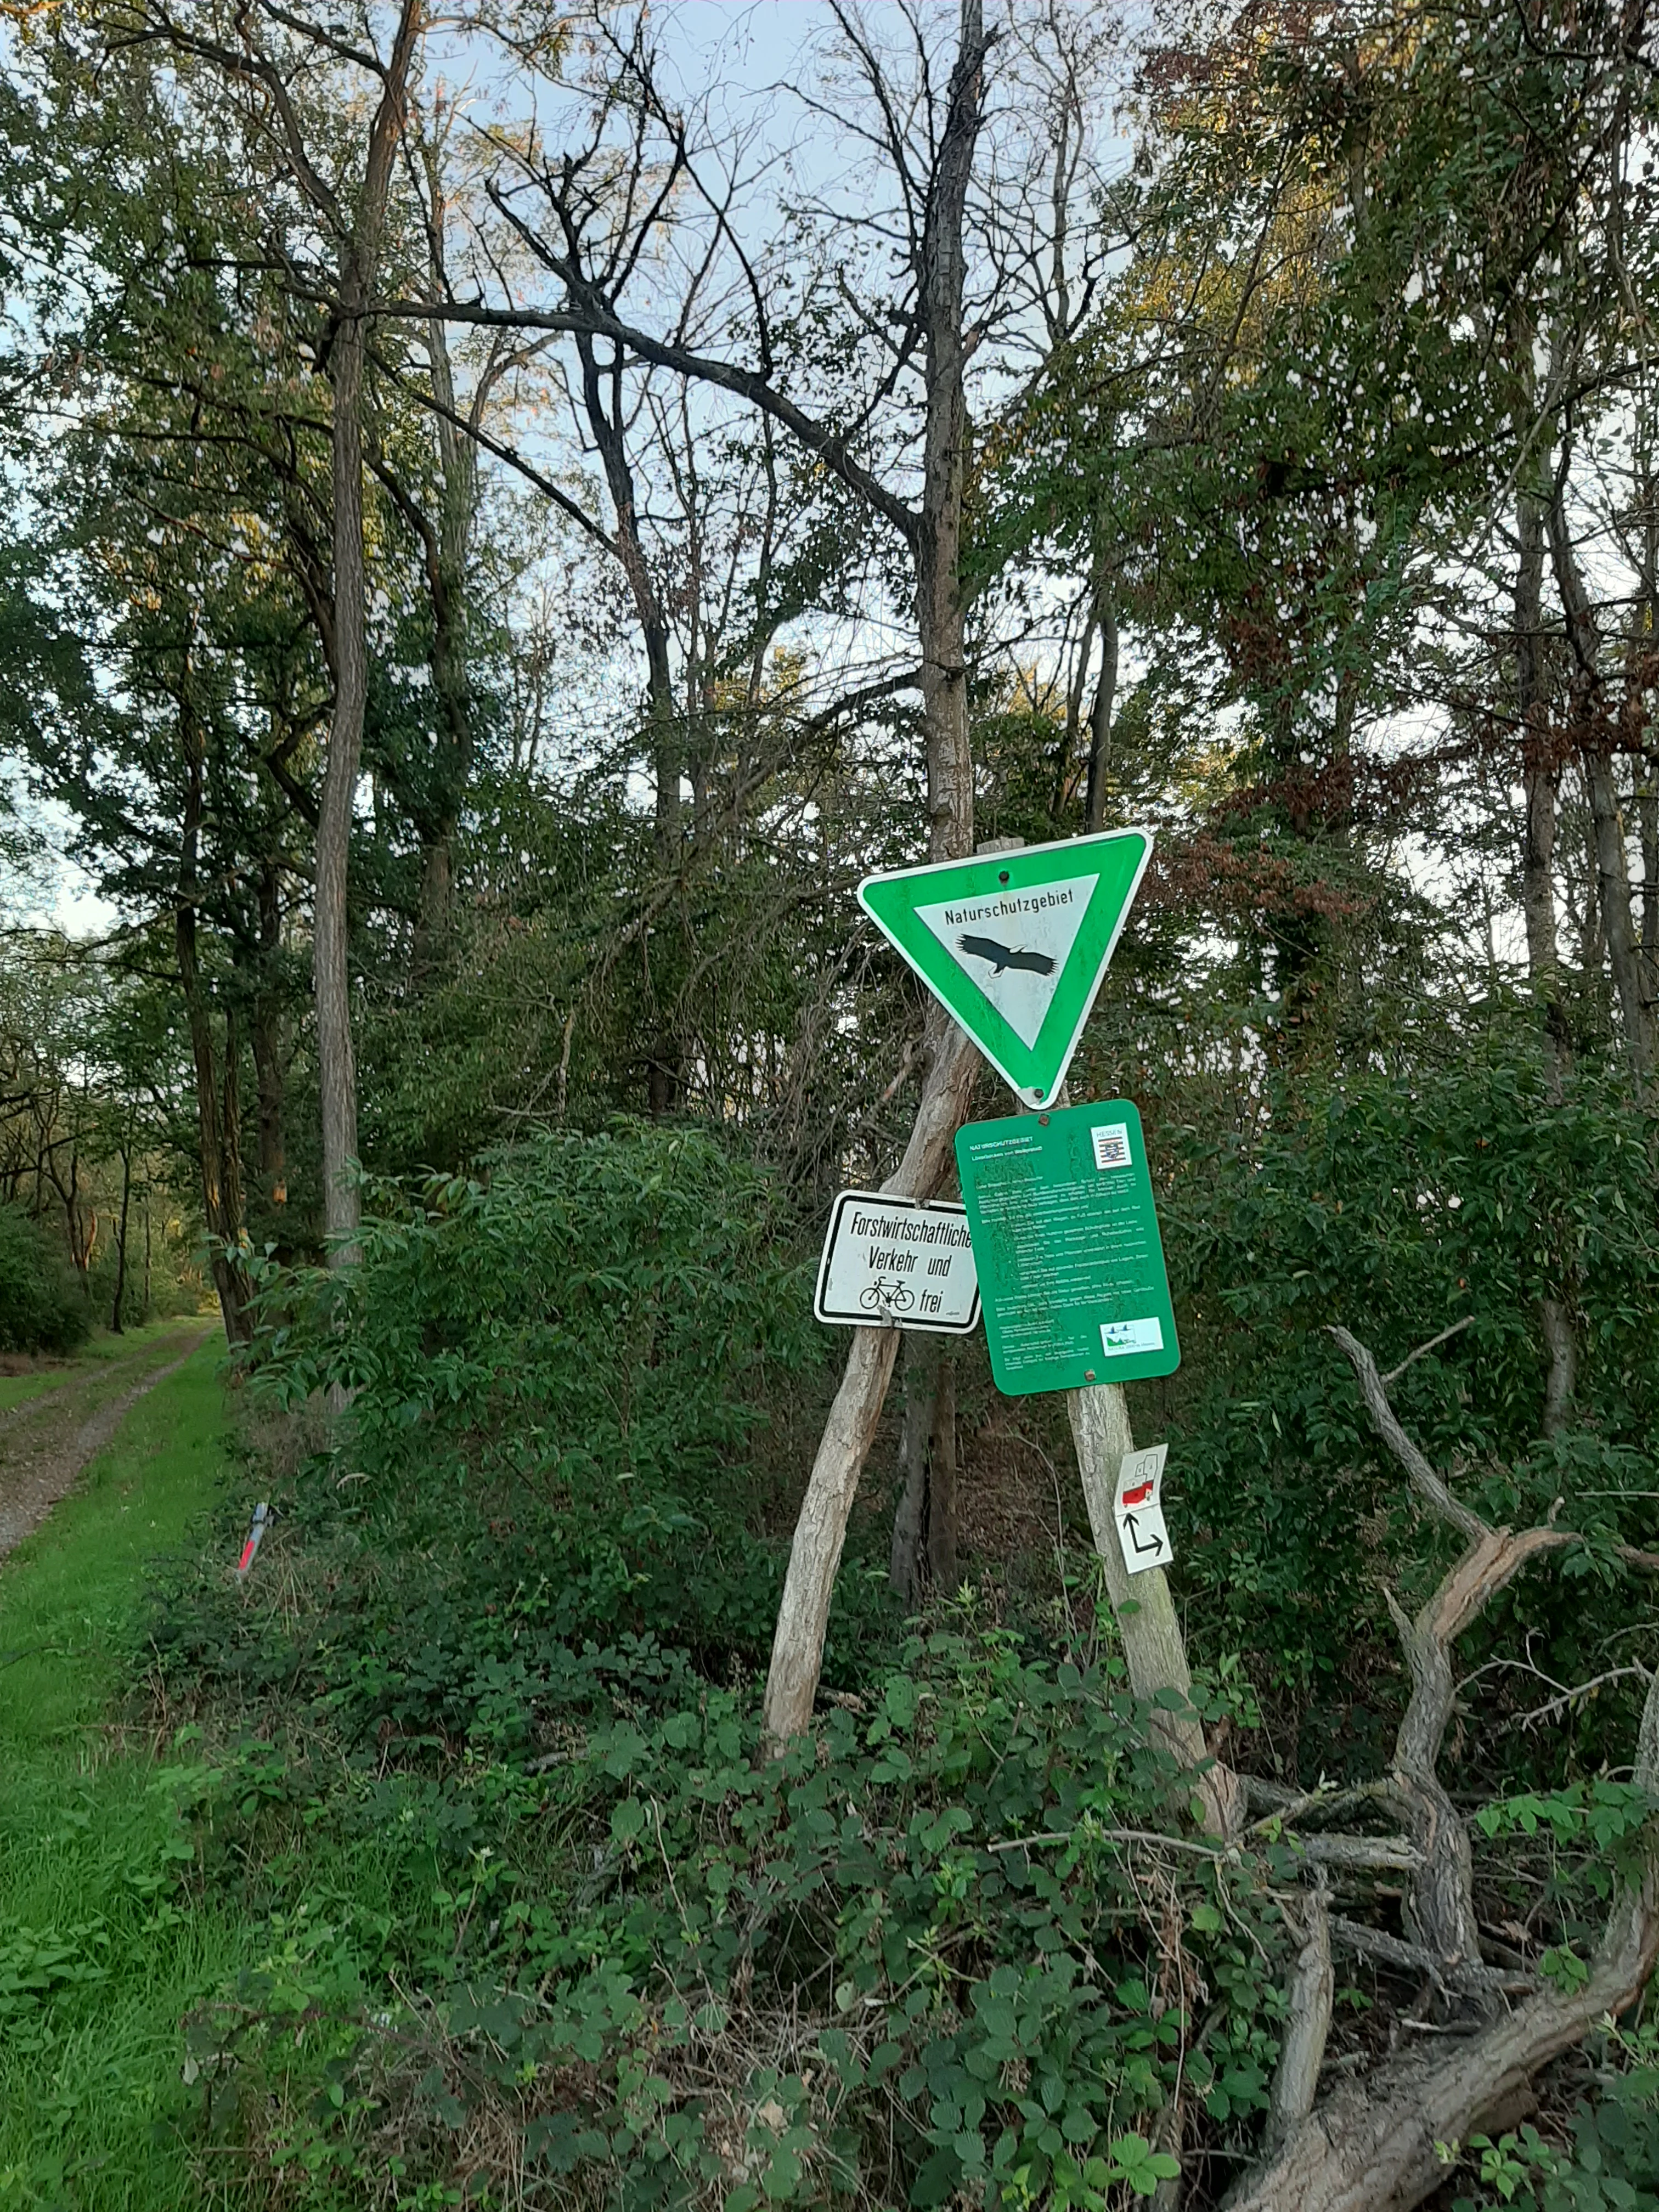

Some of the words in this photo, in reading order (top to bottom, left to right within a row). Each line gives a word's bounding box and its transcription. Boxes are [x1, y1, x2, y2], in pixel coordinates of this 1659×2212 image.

[945, 889, 1074, 925] Naturschutzgebiet
[850, 1211, 972, 1248] Forstwirtschaftliche
[869, 1245, 918, 1273] Verkehr
[927, 1255, 952, 1277] und
[919, 1289, 944, 1313] frei
